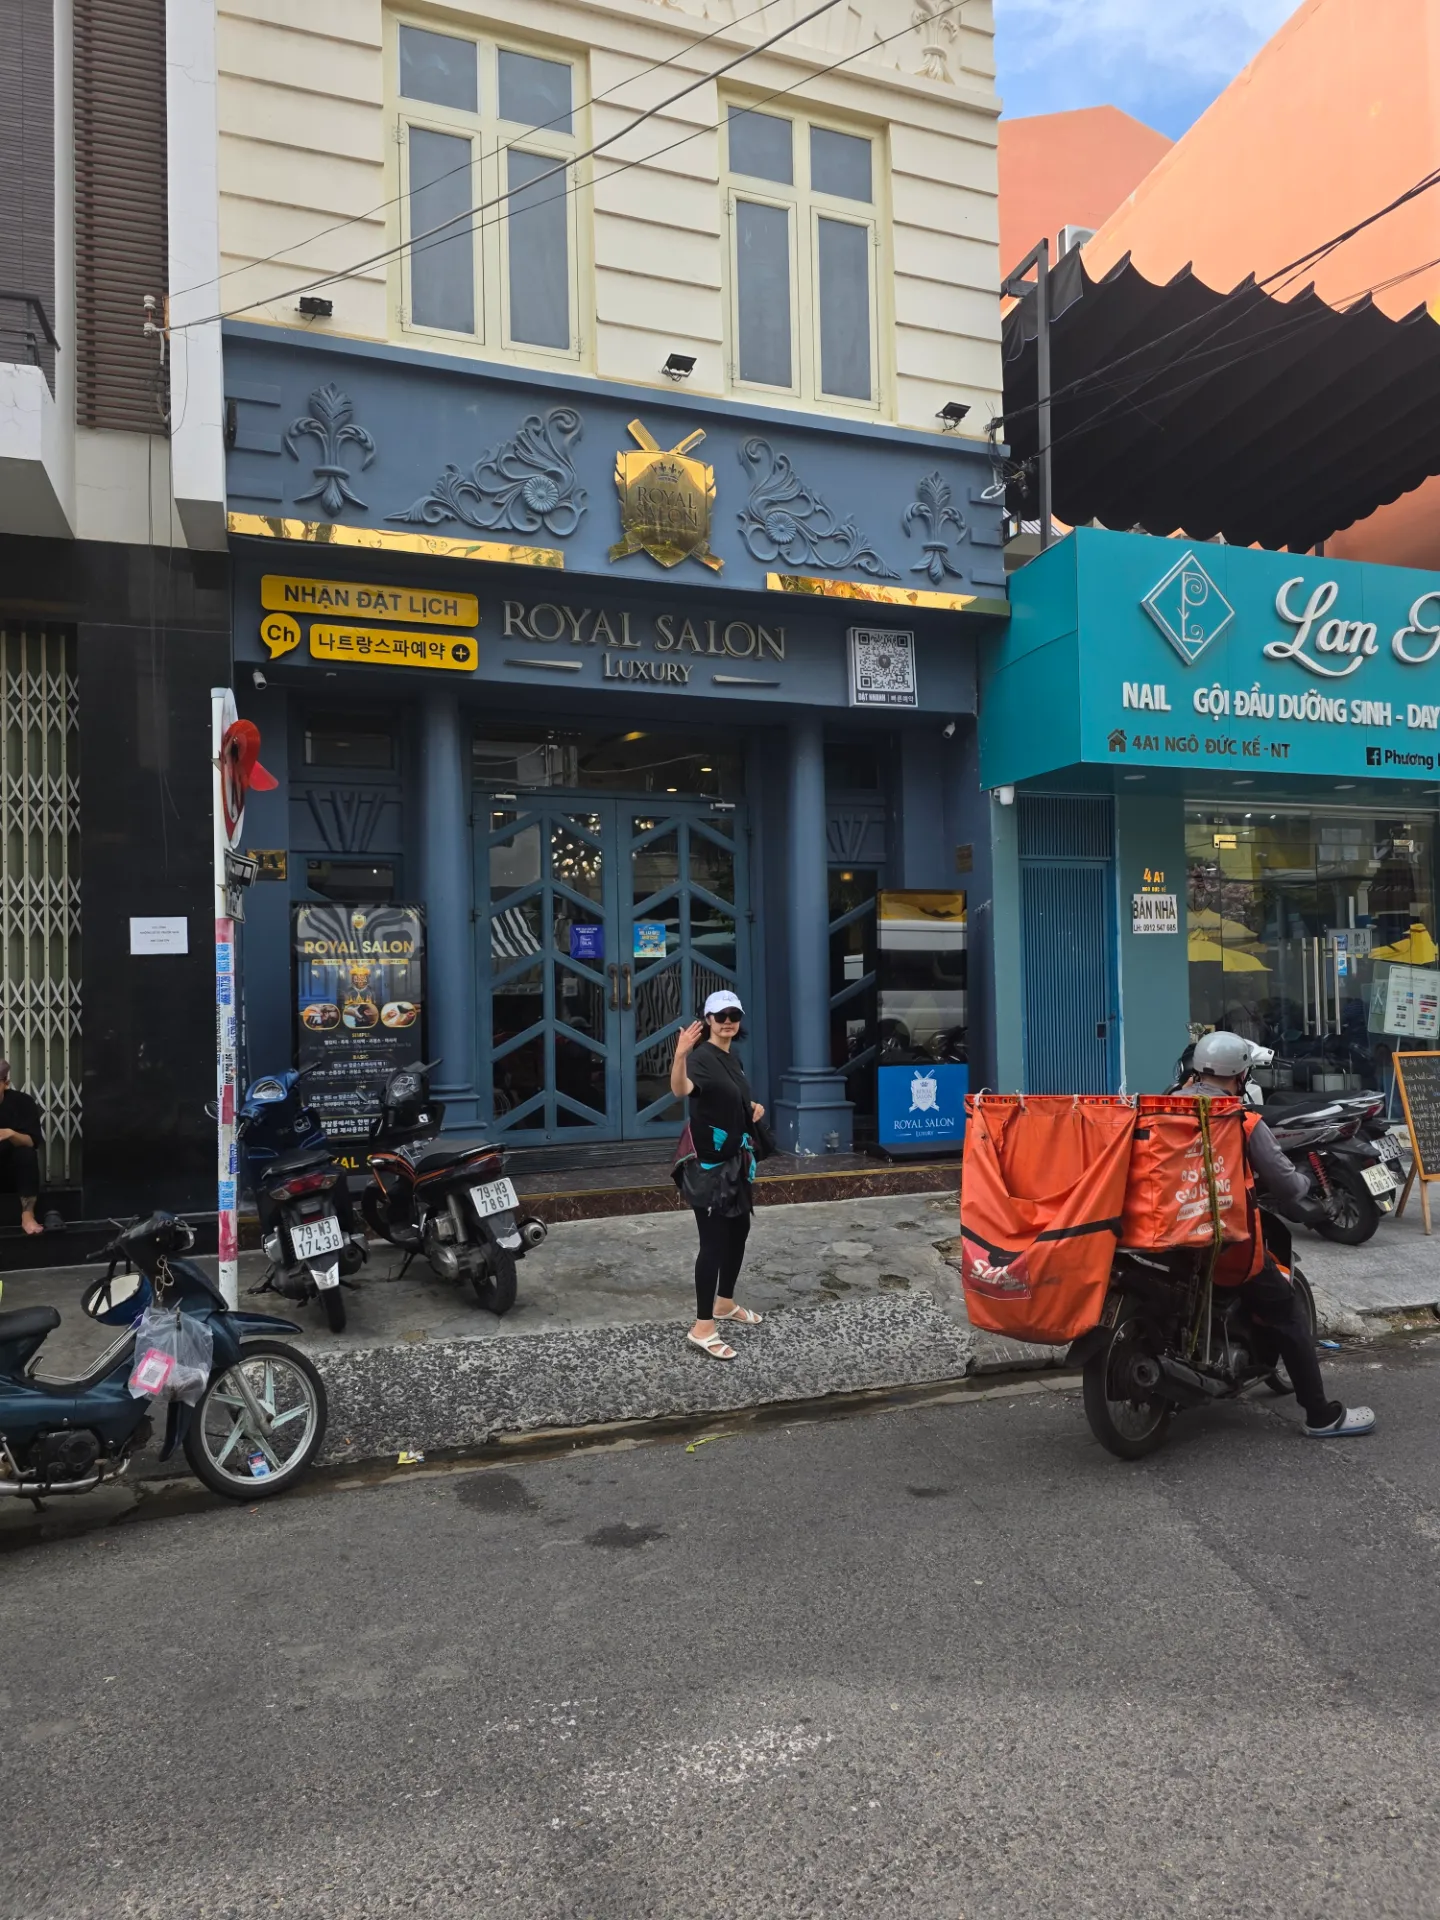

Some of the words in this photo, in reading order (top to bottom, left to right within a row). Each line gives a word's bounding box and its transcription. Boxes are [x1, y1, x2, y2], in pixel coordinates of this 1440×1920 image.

[636, 486, 697, 510] ROYAL
[284, 584, 349, 609] NHẬN
[356, 590, 402, 614] ĐẶT
[409, 596, 458, 617] LỊCH
[267, 624, 295, 642] Ch
[502, 600, 642, 648] ROYAL
[654, 614, 787, 662] SALON
[1263, 576, 1379, 677] Lan
[318, 632, 446, 660] 나트랑스파예약
[1122, 681, 1172, 711] NAIL
[1193, 682, 1230, 721] GỘI
[1234, 681, 1275, 719] ĐẦU
[1278, 688, 1347, 723] DƯỠNG
[1351, 699, 1392, 727] SINH
[1132, 735, 1160, 751] 4A1
[1164, 733, 1199, 753] NGÔ
[1205, 734, 1238, 755] ĐỨC
[1242, 734, 1261, 757] KẾ
[1271, 743, 1291, 758] NT
[1384, 749, 1434, 771] Phương
[1133, 896, 1153, 920] BÁN
[1155, 896, 1176, 920] NHÀ
[304, 941, 358, 954] ROYAL
[362, 940, 415, 953] SALON
[893, 1119, 923, 1130] ROYAL
[925, 1117, 955, 1128] SALON
[476, 1181, 508, 1200] 79-H3
[481, 1193, 511, 1213] 7867
[298, 1220, 332, 1241] 79-N3
[298, 1233, 340, 1257] 174.38
